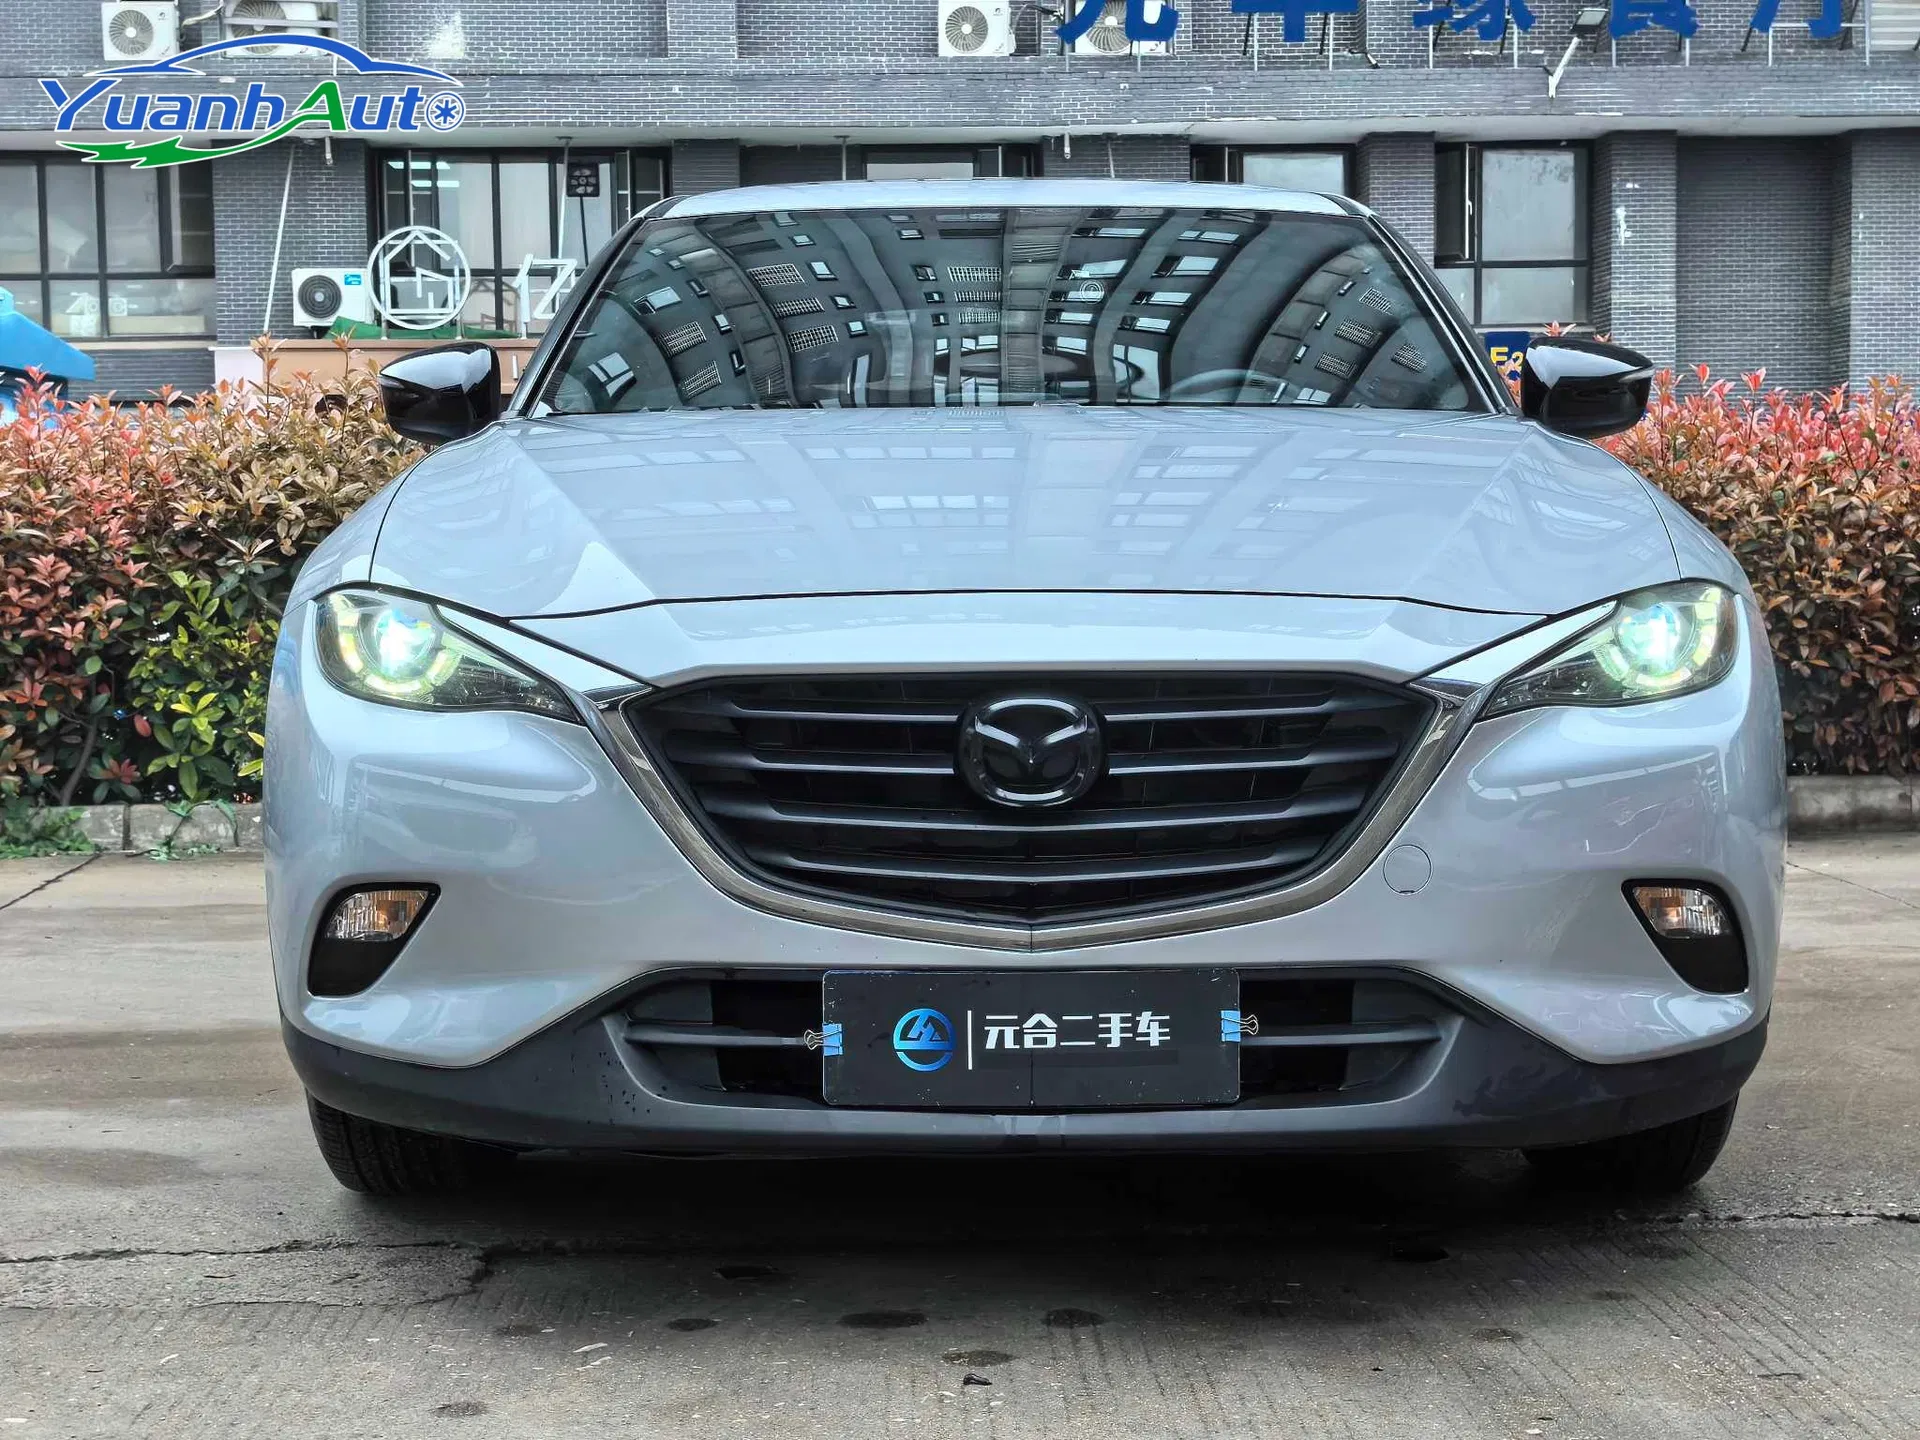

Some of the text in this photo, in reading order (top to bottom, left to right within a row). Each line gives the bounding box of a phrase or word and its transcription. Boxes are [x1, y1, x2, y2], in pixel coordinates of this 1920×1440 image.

[984, 1011, 1171, 1050] 元合二手车
